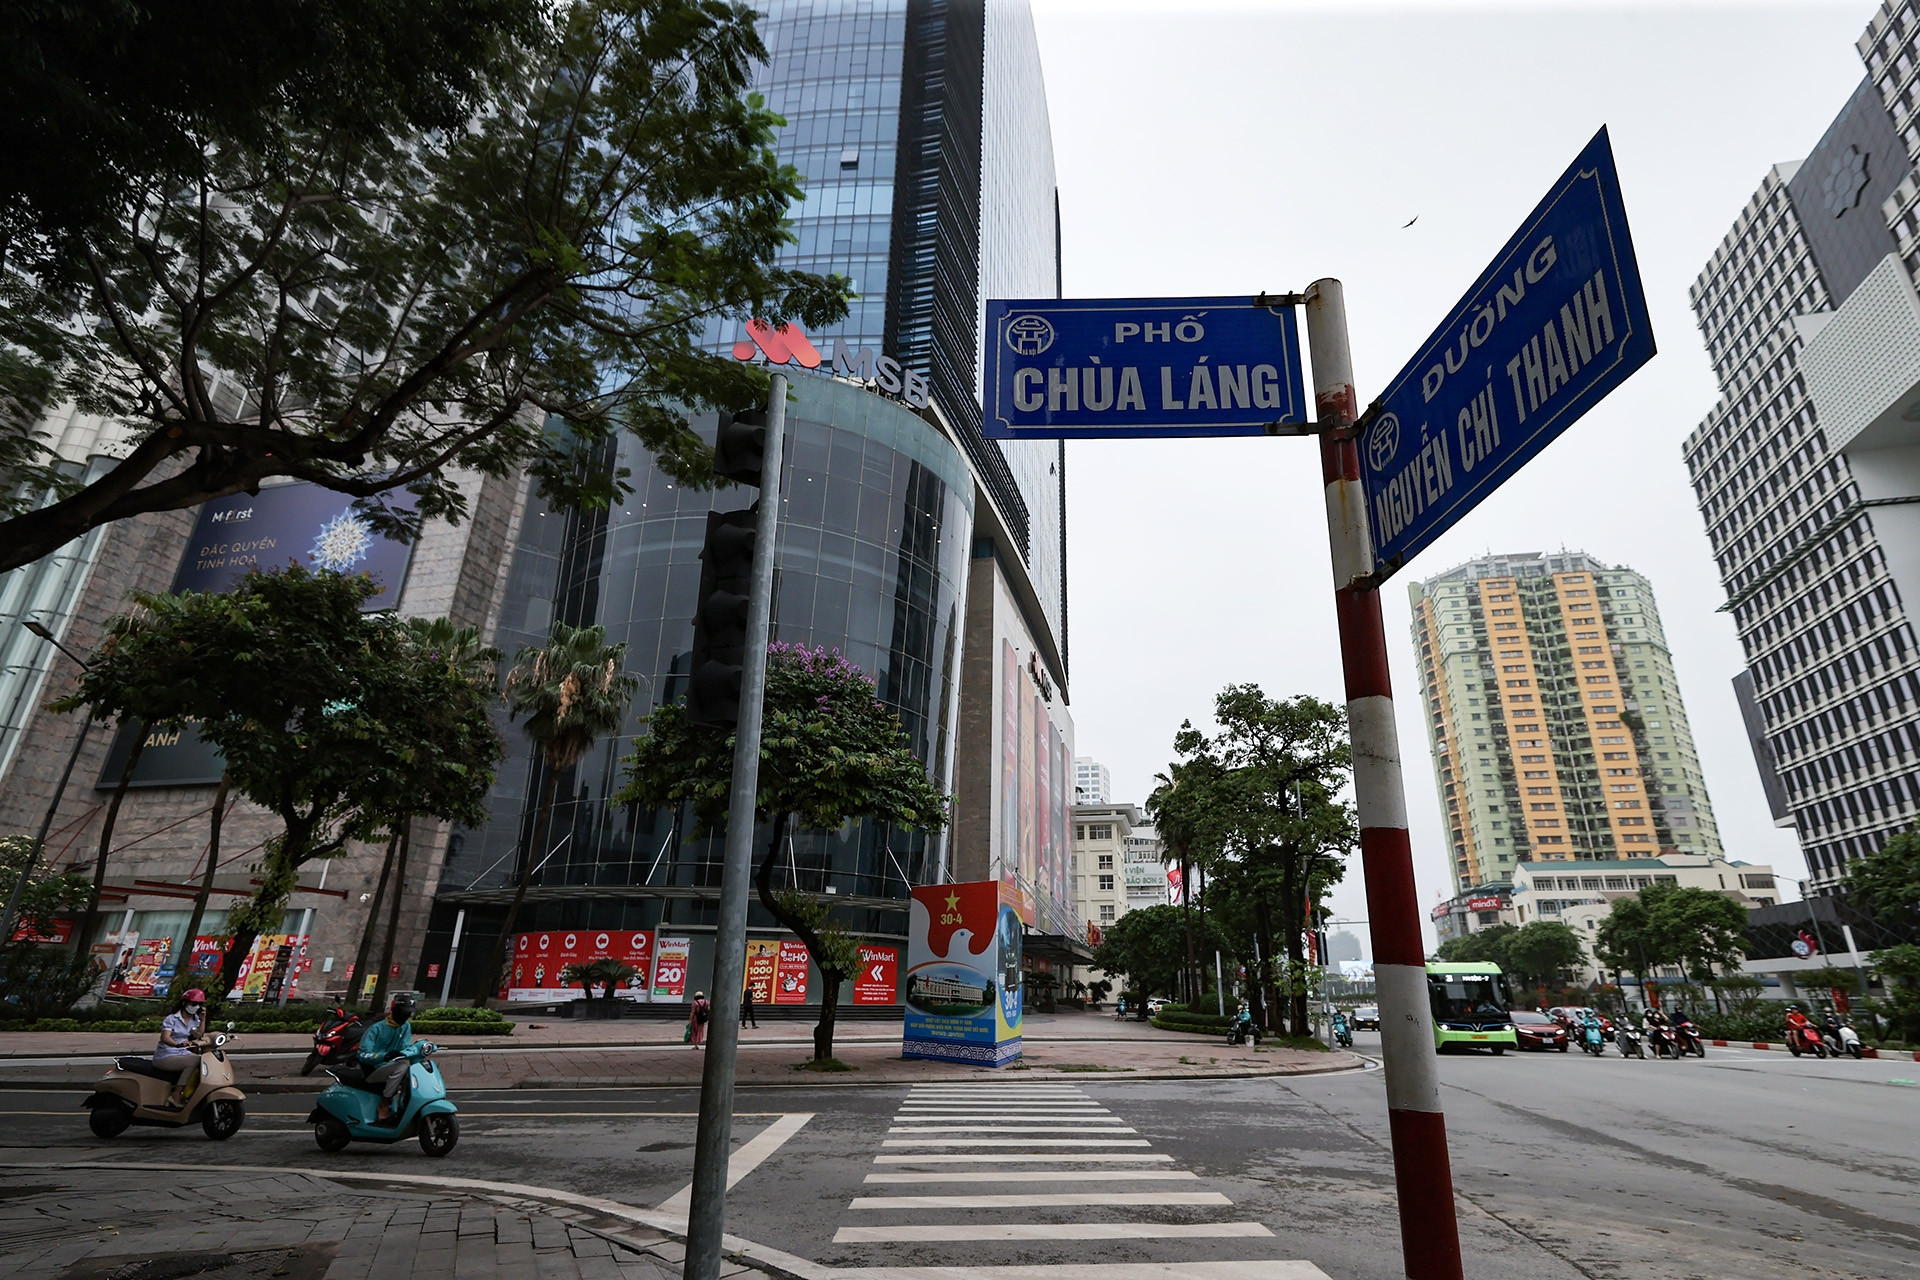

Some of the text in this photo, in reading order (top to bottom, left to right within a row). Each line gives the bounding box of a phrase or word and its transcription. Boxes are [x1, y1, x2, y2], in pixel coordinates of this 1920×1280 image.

[1115, 312, 1208, 343] PHỐ
[1422, 235, 1557, 403] ĐƯỜNG
[832, 338, 929, 410] MSB
[1013, 355, 1281, 411] CHÙA LÁNG
[1375, 268, 1615, 548] NGUYỄN CHÍ THANH
[200, 535, 277, 558] ĐẶC QUYỀN
[196, 558, 226, 571] TINH
[940, 913, 963, 925] 30-4
[192, 939, 230, 953] WinMt
[660, 940, 691, 949] WinMart
[749, 966, 773, 975] 1000
